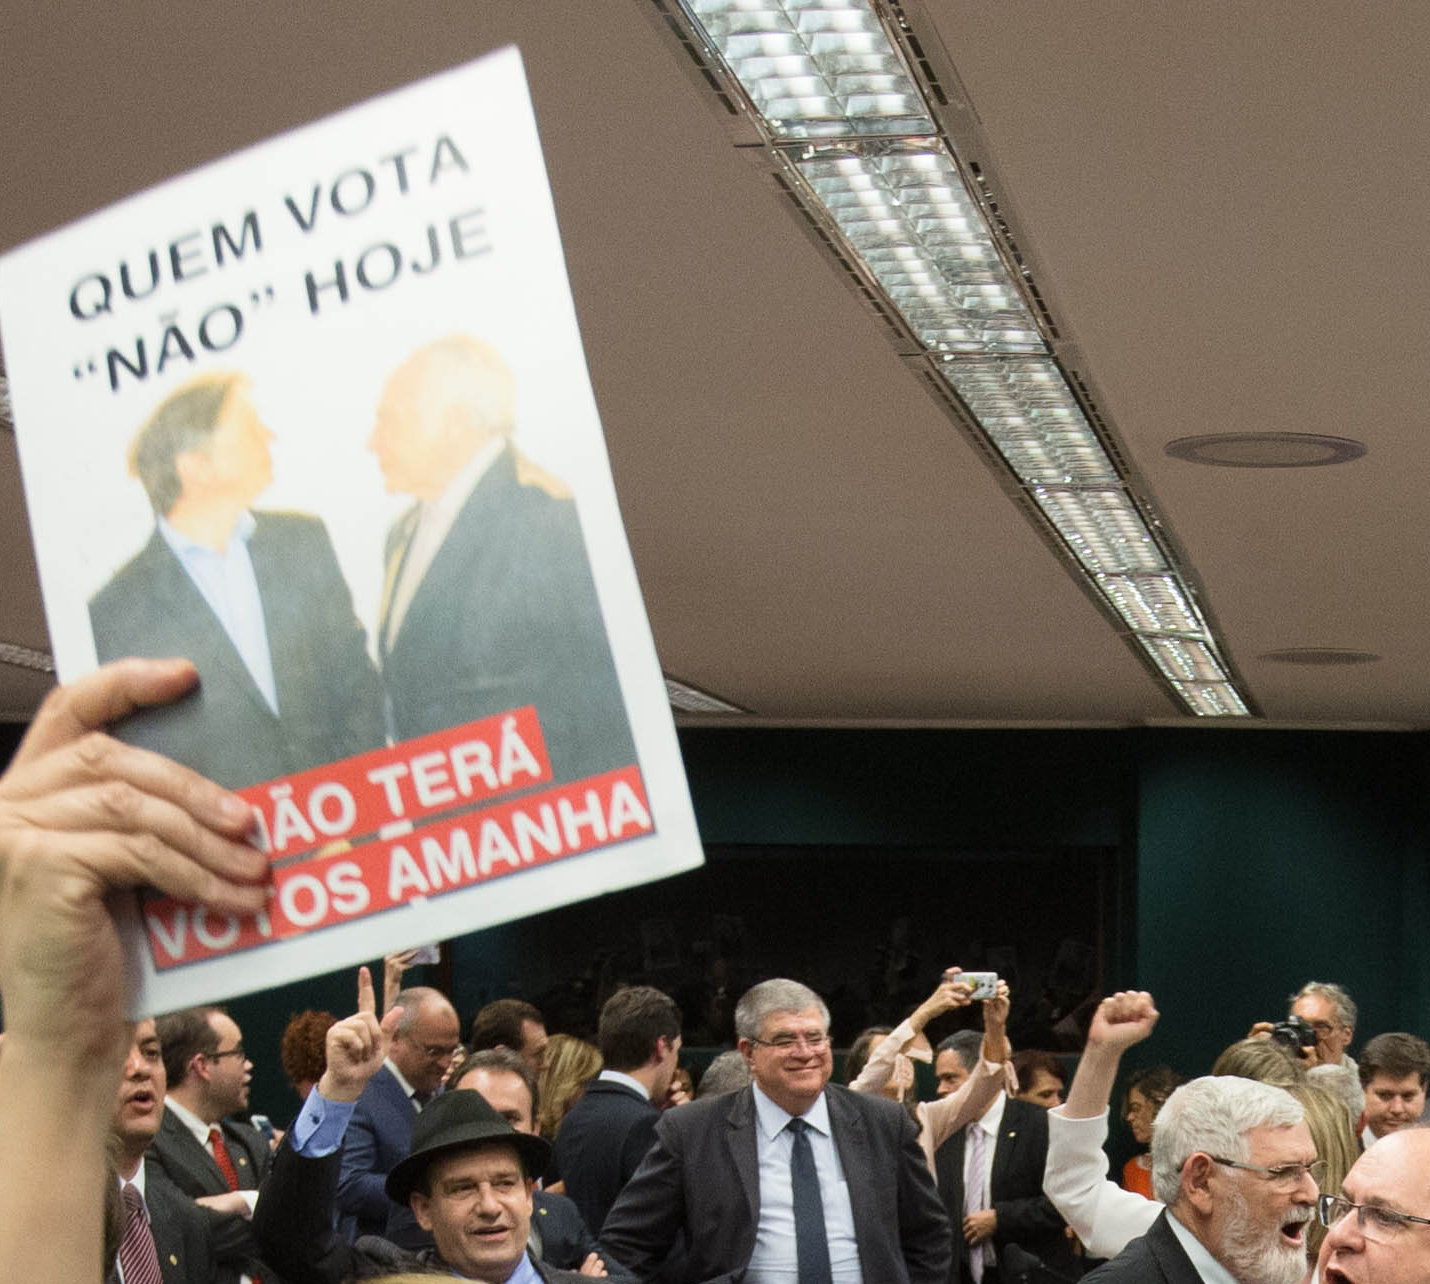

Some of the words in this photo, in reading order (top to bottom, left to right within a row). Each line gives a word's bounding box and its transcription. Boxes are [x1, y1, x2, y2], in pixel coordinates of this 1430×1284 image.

[69, 210, 264, 321] QUEM
[283, 131, 471, 234] VOTA
[304, 207, 493, 316] HOJE
[367, 715, 542, 818] TERÁ
[387, 779, 653, 903] AMANHA
